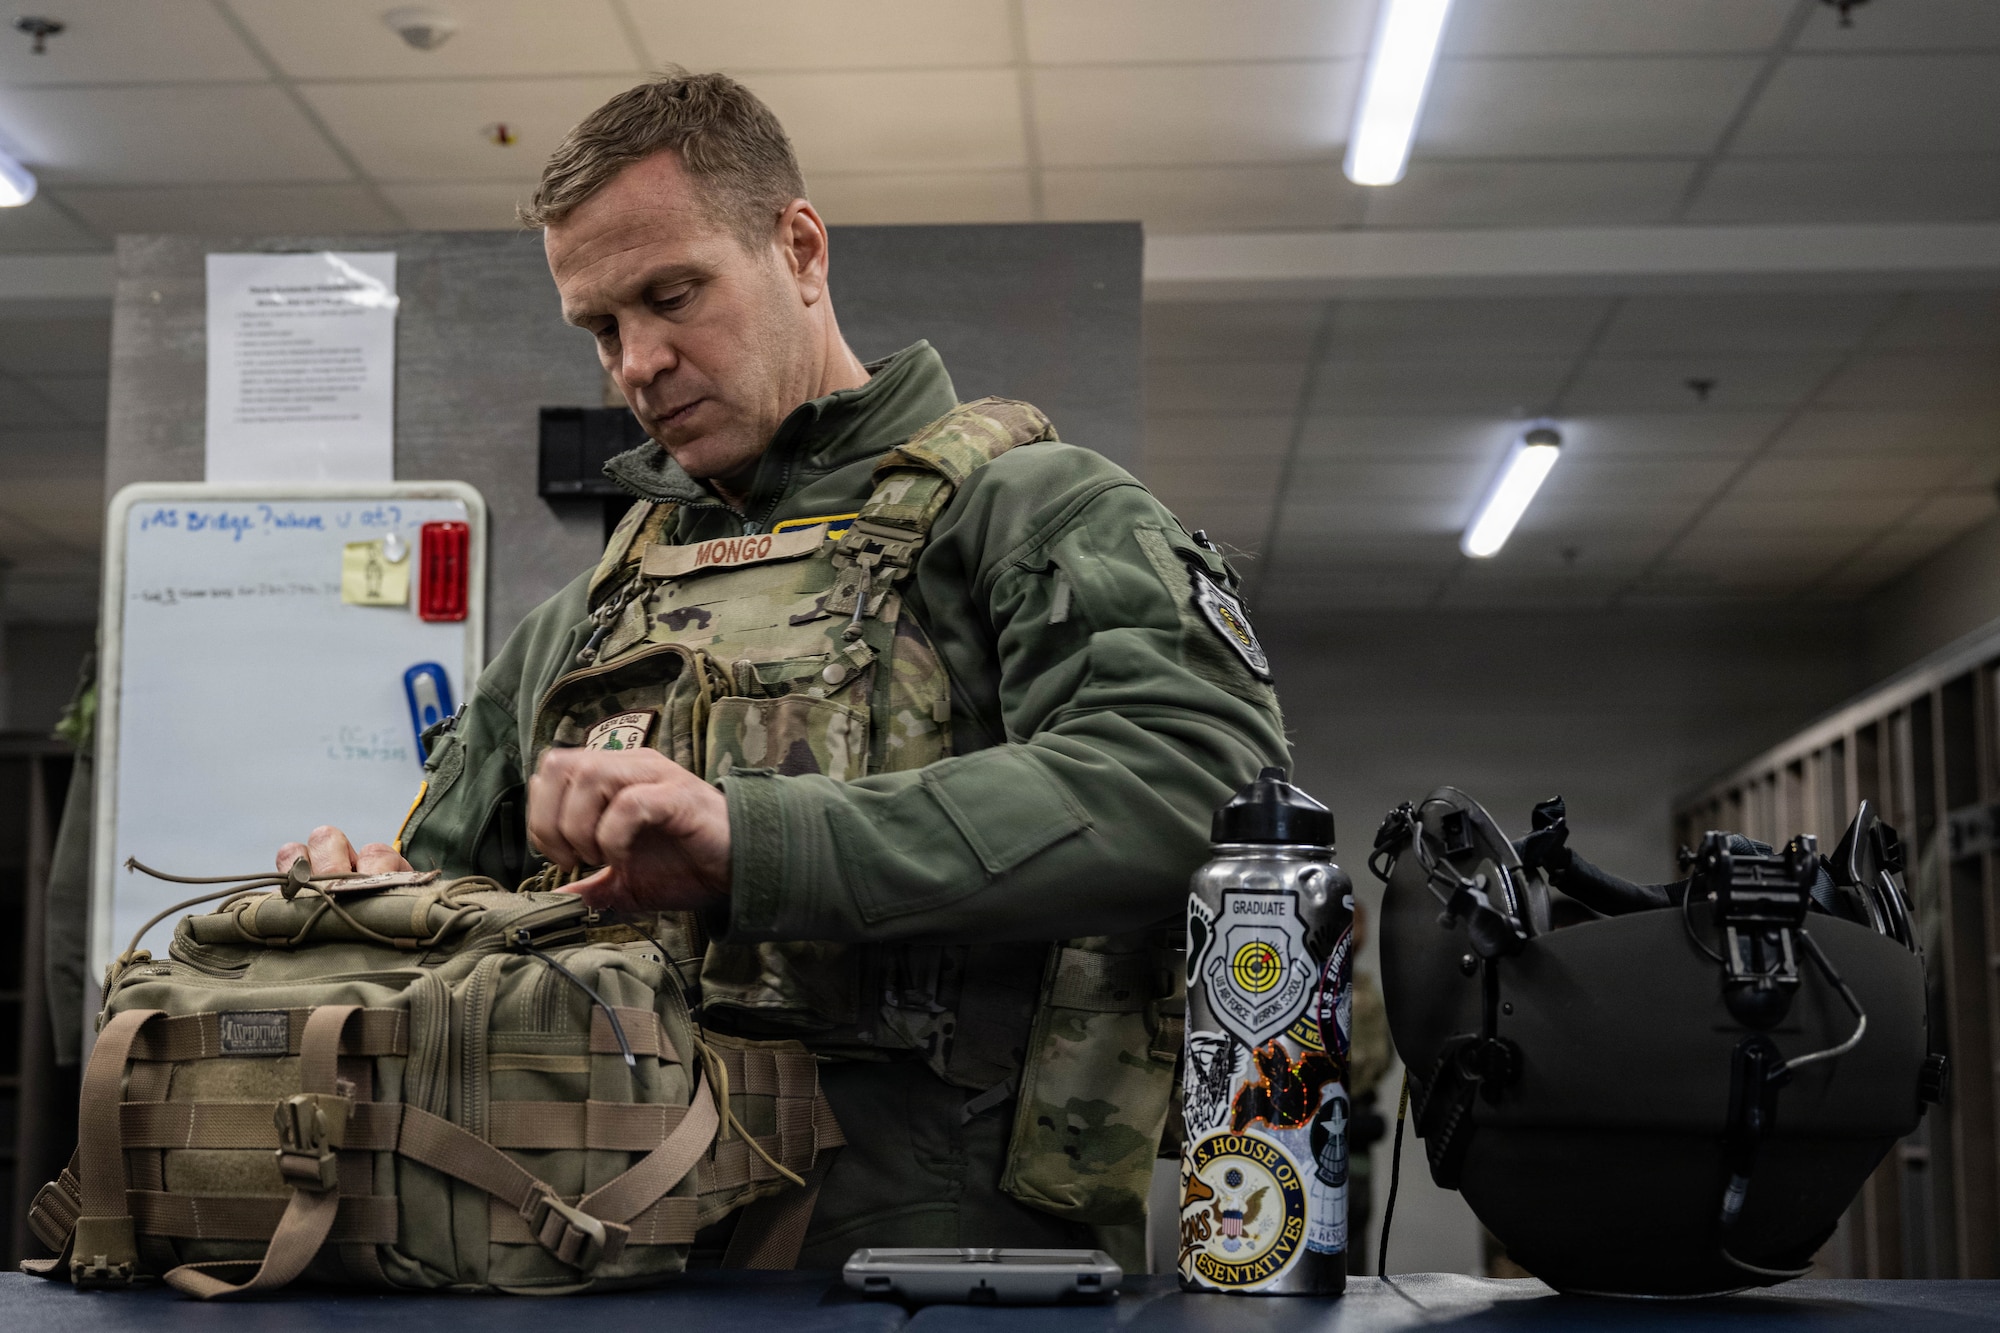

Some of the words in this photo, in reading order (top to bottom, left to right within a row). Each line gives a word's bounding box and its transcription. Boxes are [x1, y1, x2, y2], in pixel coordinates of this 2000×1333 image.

[694, 535, 772, 567] MONGO
[1232, 899, 1286, 916] GRADUATE
[1215, 975, 1225, 988] US
[1279, 978, 1302, 1006] SCHOOL
[1218, 986, 1232, 1003] AIR
[1226, 996, 1251, 1021] FORCE
[1212, 1136, 1278, 1168] HOUSE
[1275, 1164, 1300, 1192] OF
